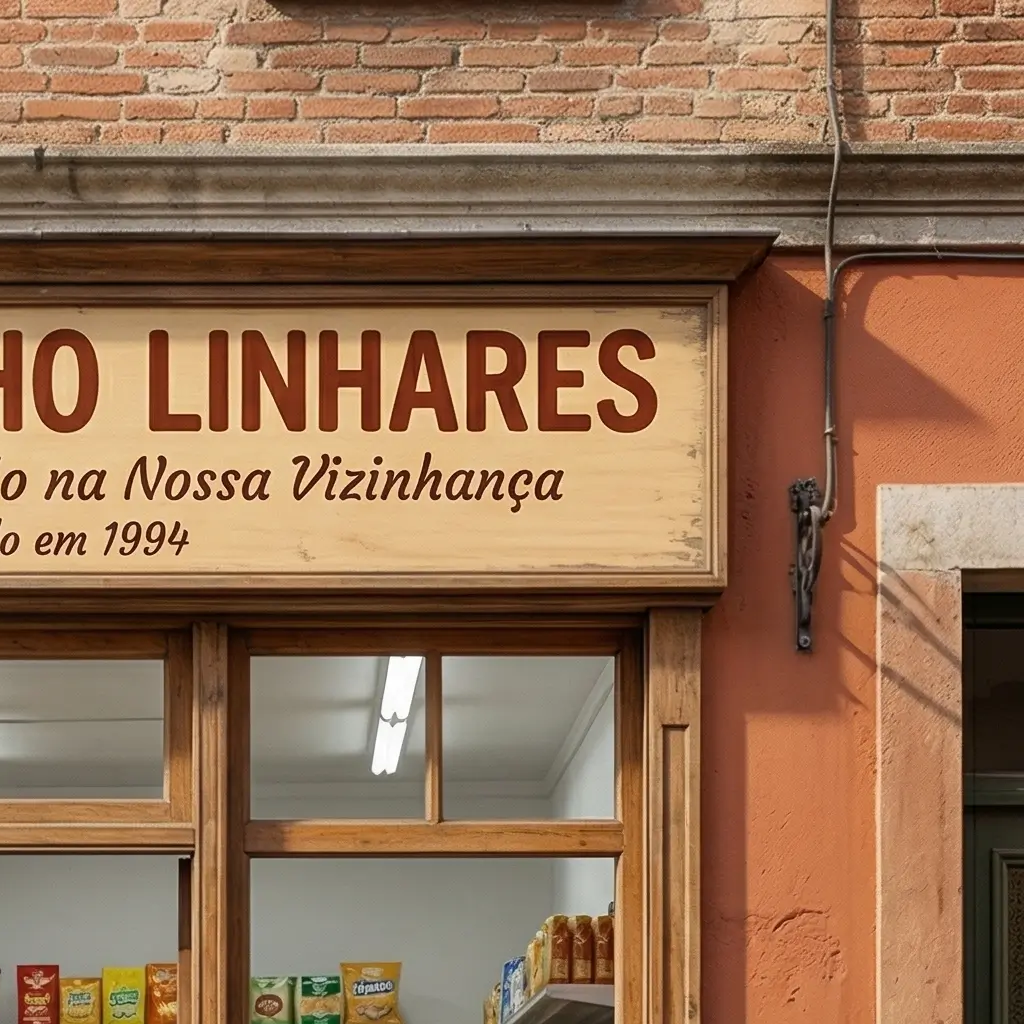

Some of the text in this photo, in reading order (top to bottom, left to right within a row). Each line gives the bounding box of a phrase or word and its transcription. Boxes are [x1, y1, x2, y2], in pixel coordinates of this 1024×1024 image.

[149, 329, 659, 433] LINHARES
[45, 470, 106, 501] na
[124, 456, 271, 501] Nossa
[292, 452, 564, 514] Vizinhança
[35, 532, 86, 556] em
[104, 521, 189, 558] 1994
